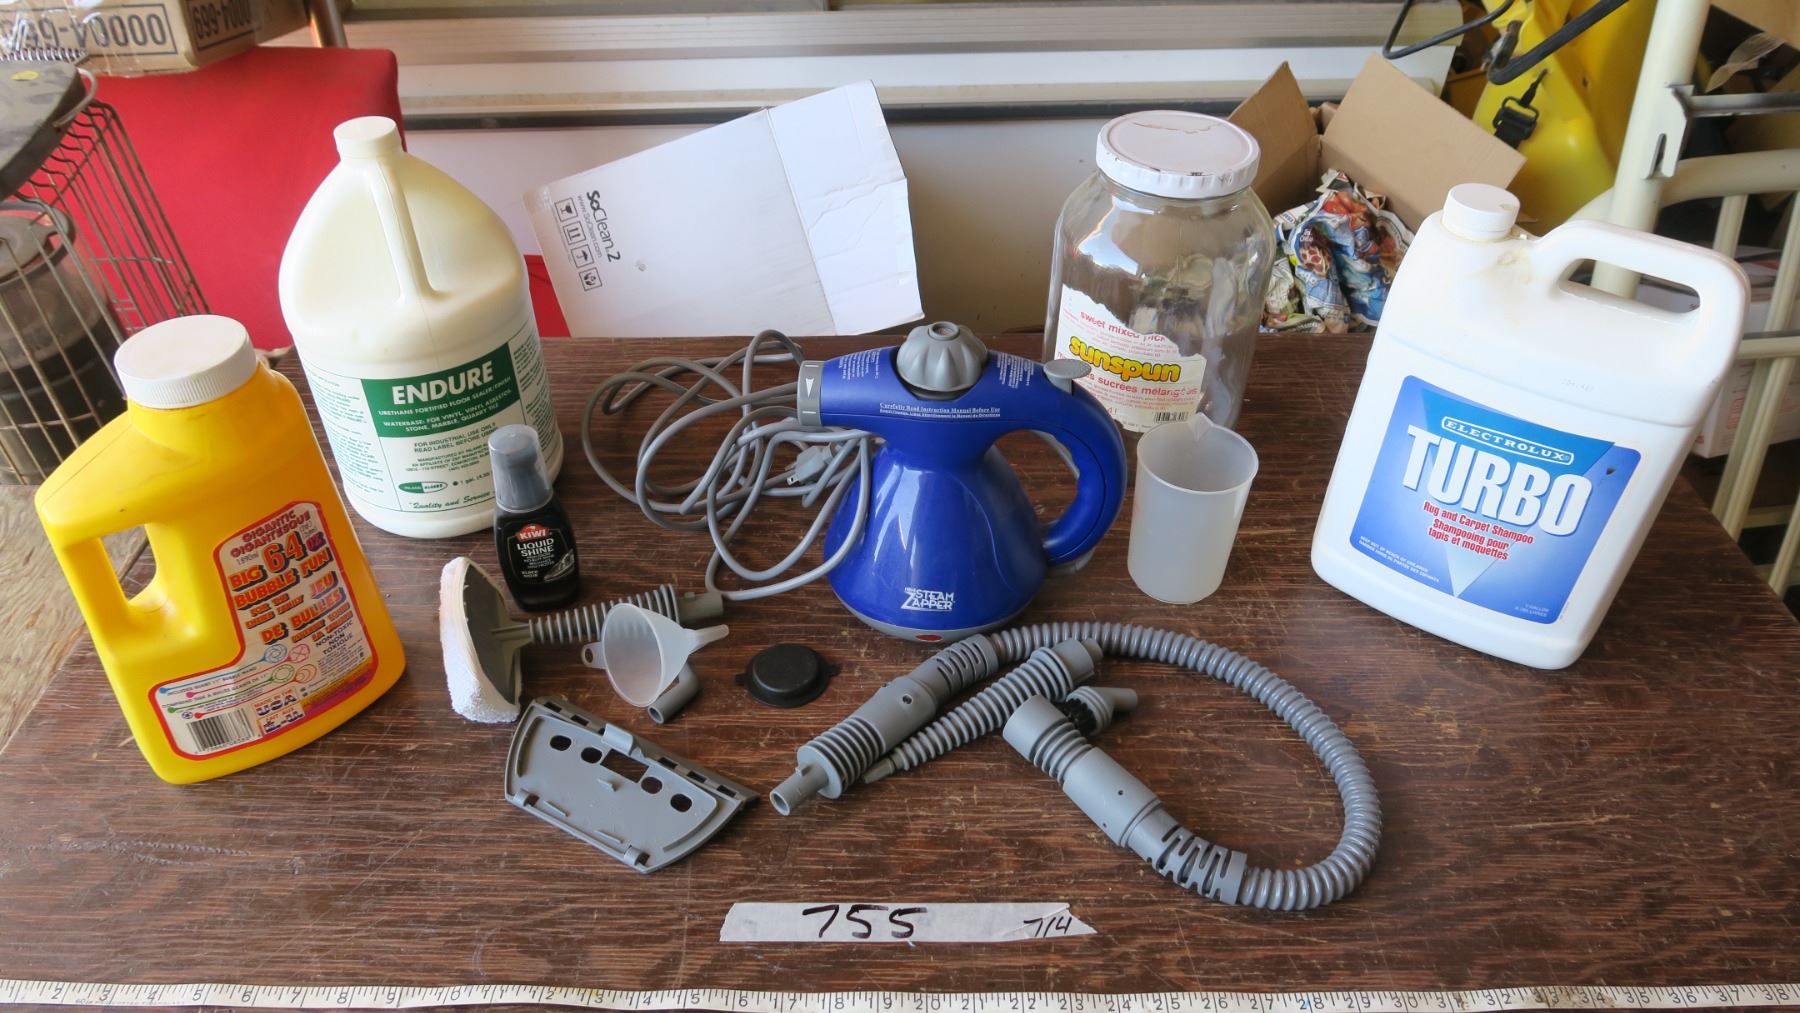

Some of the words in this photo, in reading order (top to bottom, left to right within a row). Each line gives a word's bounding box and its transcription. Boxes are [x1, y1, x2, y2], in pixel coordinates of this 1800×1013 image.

[1080, 311, 1105, 328] sweet
[1069, 336, 1181, 383] sunspun
[392, 360, 494, 405] ENDURE
[415, 403, 448, 414] FORTIFIED
[449, 397, 470, 407] FLOOR
[429, 434, 465, 446] INDUSTRIAL
[1445, 418, 1565, 461] ELECTROLUX
[1401, 424, 1593, 537] TURBO
[230, 510, 311, 557] GIGANTESQUE
[242, 510, 296, 542] GIGANTIC
[520, 529, 546, 540] KIWI
[1423, 501, 1440, 516] Rug
[1441, 509, 1457, 521] and
[1459, 514, 1490, 532] Carpet
[1491, 525, 1534, 545] Shampoo
[1433, 518, 1486, 545] Shampooing
[1486, 538, 1510, 550] pour
[262, 530, 308, 573] 64
[517, 538, 554, 550] LIQUID
[521, 545, 554, 557] SHINE
[1428, 527, 1450, 542] tapis
[1451, 535, 1461, 546] et
[1461, 540, 1508, 560] moquettes
[229, 565, 268, 592] BIG
[234, 568, 300, 610] BUBBLE
[299, 546, 333, 578] FUN
[310, 570, 338, 599] JEU
[901, 590, 953, 611] ZAPPER
[916, 588, 955, 602] STEAM
[260, 622, 289, 645] DE
[290, 586, 347, 630] BULLES
[316, 620, 354, 648] NON-TOXIC
[323, 632, 354, 655] TOXIQUE
[328, 633, 345, 646] NON
[801, 904, 928, 939] 755
[51, 988, 62, 1000] 2
[99, 989, 109, 1001] 3
[147, 990, 157, 1001] 4
[192, 989, 202, 1001] 5
[241, 990, 251, 1003] 6
[290, 990, 301, 1004] 7
[336, 991, 347, 1004] 8
[385, 991, 395, 1005] 9
